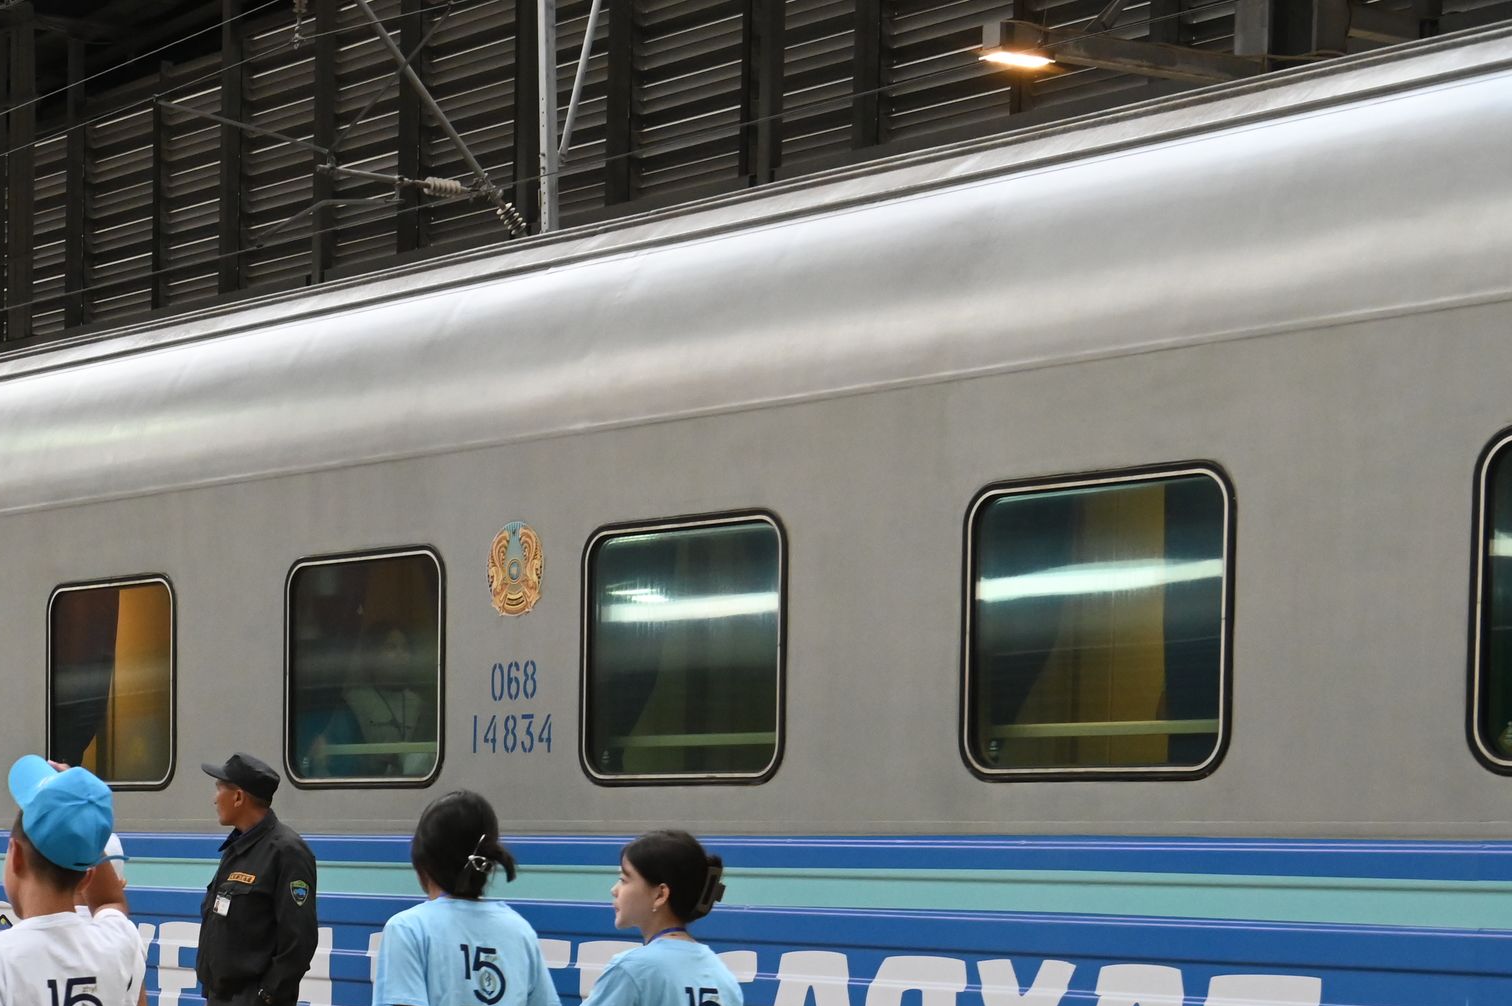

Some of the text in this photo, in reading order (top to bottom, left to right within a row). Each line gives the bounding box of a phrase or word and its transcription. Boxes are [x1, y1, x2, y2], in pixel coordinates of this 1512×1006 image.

[491, 660, 537, 701] 068
[472, 714, 552, 753] 14834
[460, 944, 506, 1005] 15
